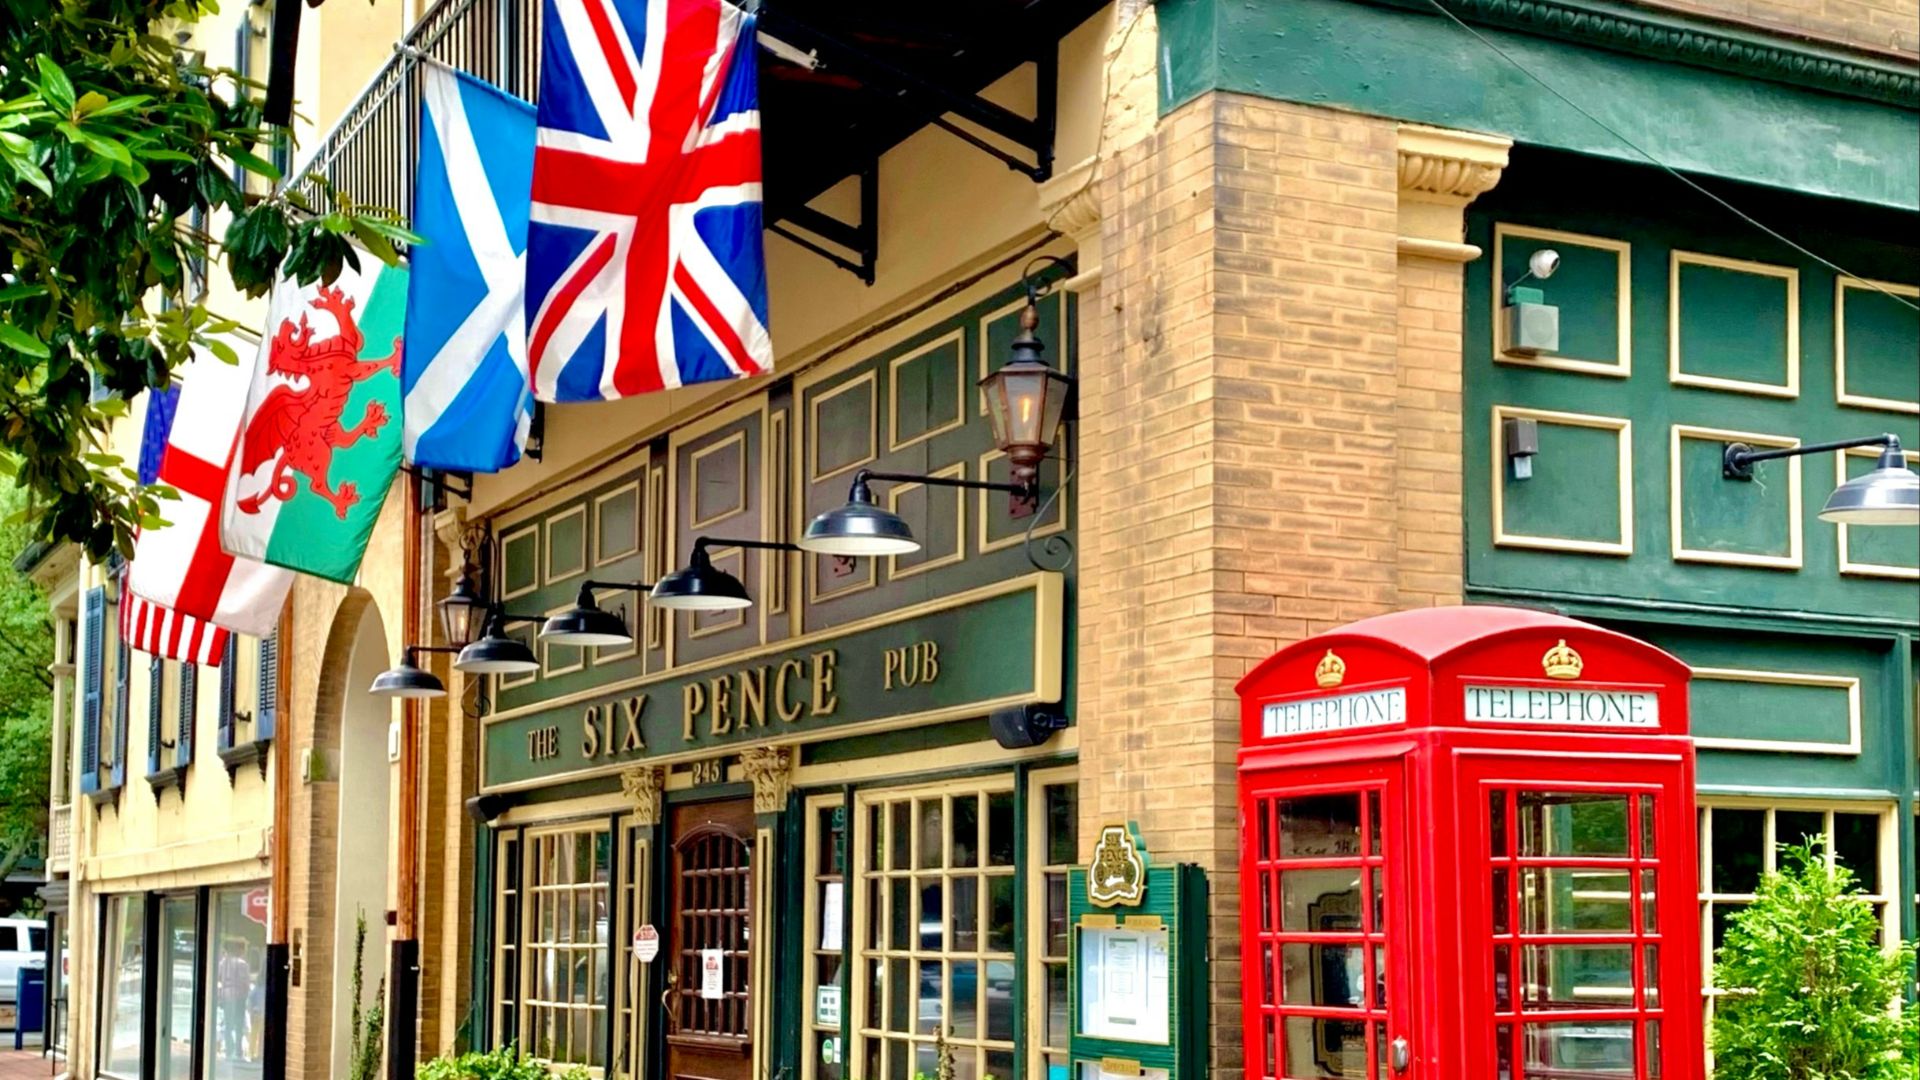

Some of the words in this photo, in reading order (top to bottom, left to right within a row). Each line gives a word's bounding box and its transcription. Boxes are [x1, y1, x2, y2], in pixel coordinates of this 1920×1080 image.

[528, 726, 559, 760] THE
[582, 694, 646, 759] SIX
[682, 650, 838, 740] PENCE
[884, 641, 938, 690] PUB
[1270, 692, 1401, 734] TELEPHONE
[1468, 687, 1646, 723] TELEPHONE
[693, 760, 720, 784] 245
